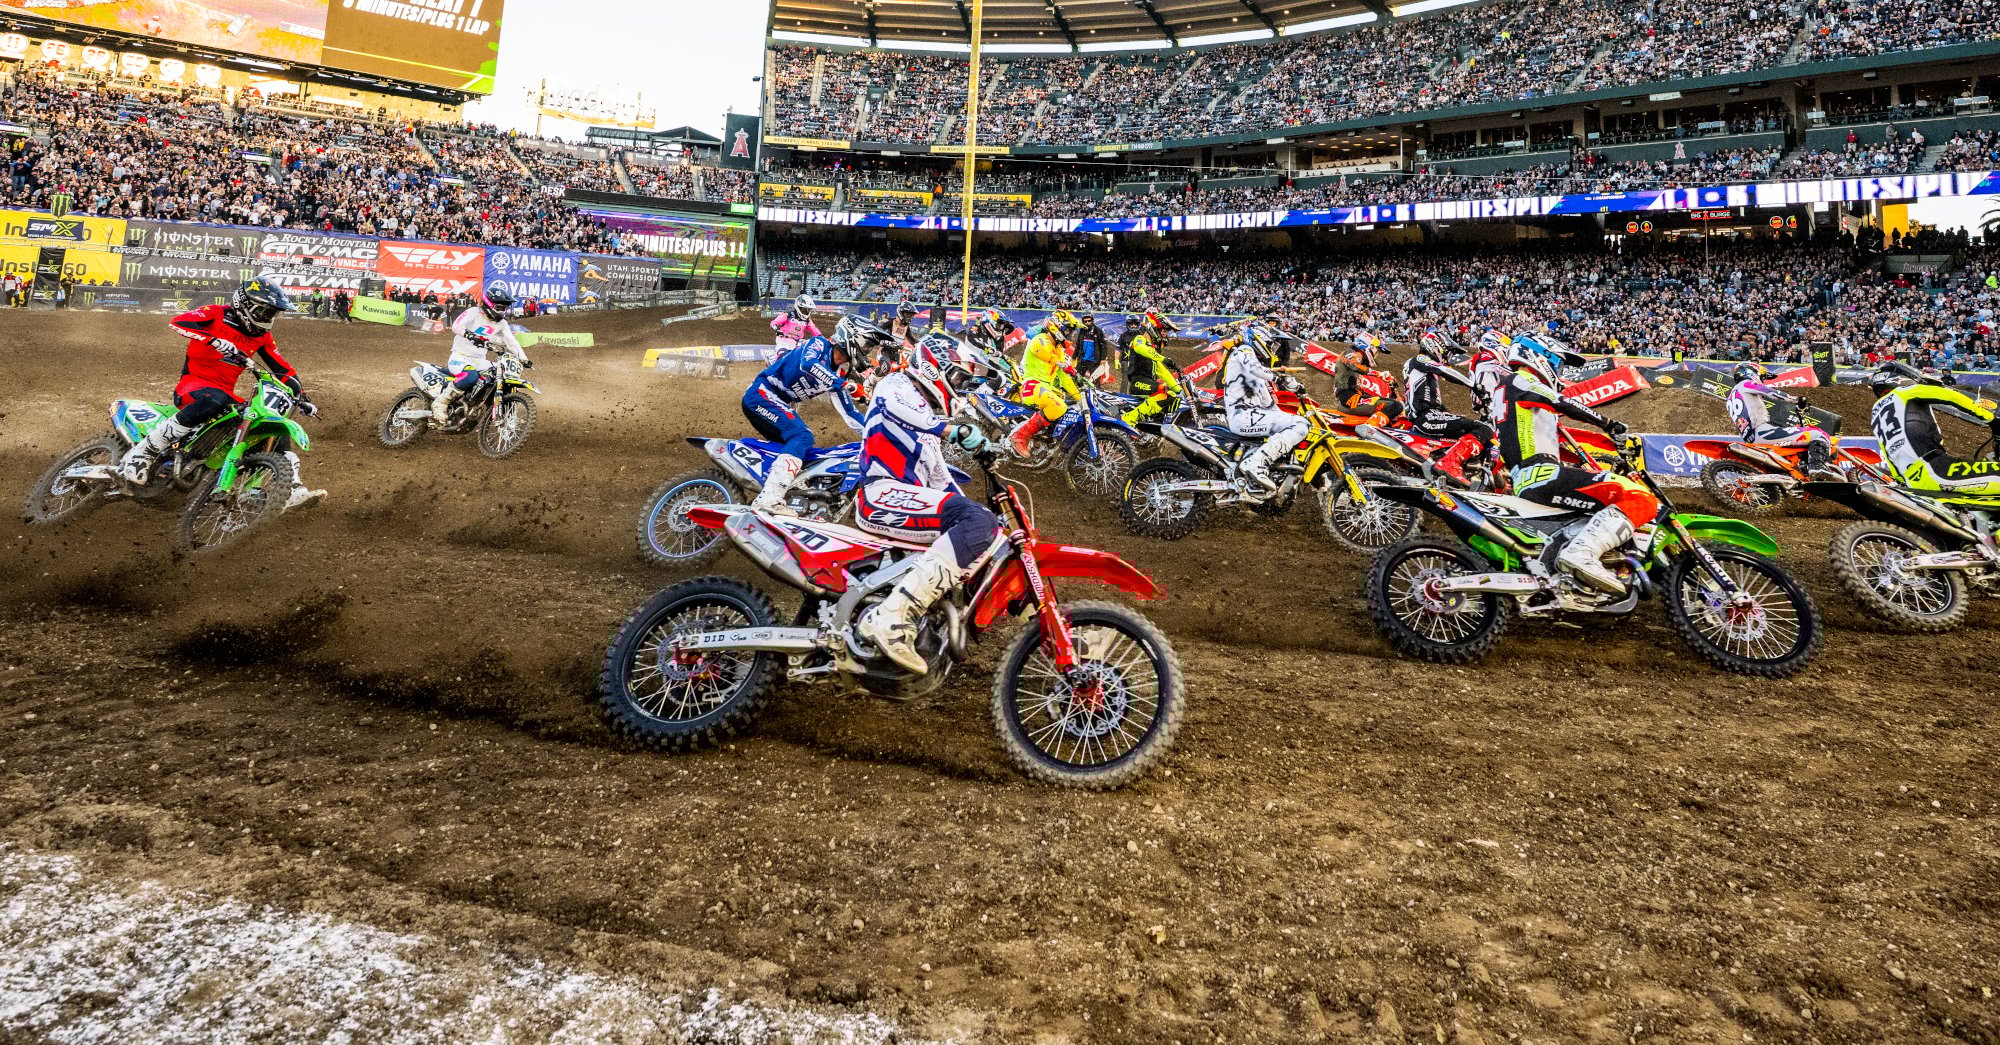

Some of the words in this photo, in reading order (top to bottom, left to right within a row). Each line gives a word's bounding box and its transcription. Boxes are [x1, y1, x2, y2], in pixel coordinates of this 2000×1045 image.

[355, 0, 456, 29] MINUTES/PLUS
[463, 17, 490, 36] LAP
[541, 186, 566, 196] DESK
[28, 221, 78, 237] SMX
[281, 233, 317, 244] ROCKY
[319, 236, 379, 249] MOUNTAIN
[511, 253, 572, 273] YAMAHA
[607, 264, 629, 272] UTAH
[631, 266, 660, 275] SPORTS
[149, 264, 231, 280] MONSTER
[498, 270, 567, 279] RACING
[607, 271, 659, 282] COMMISSION
[161, 278, 219, 286] ENERGY
[508, 281, 570, 300] YAMAHA
[362, 304, 401, 317] Kawasaki
[537, 337, 580, 346] Kawasaki
[809, 364, 834, 386] YAMAHA
[754, 404, 780, 423] YAMAHA
[1422, 421, 1448, 430] DUCATI
[732, 446, 764, 465] 64
[858, 518, 891, 533] HONDA
[703, 634, 725, 643] DID
